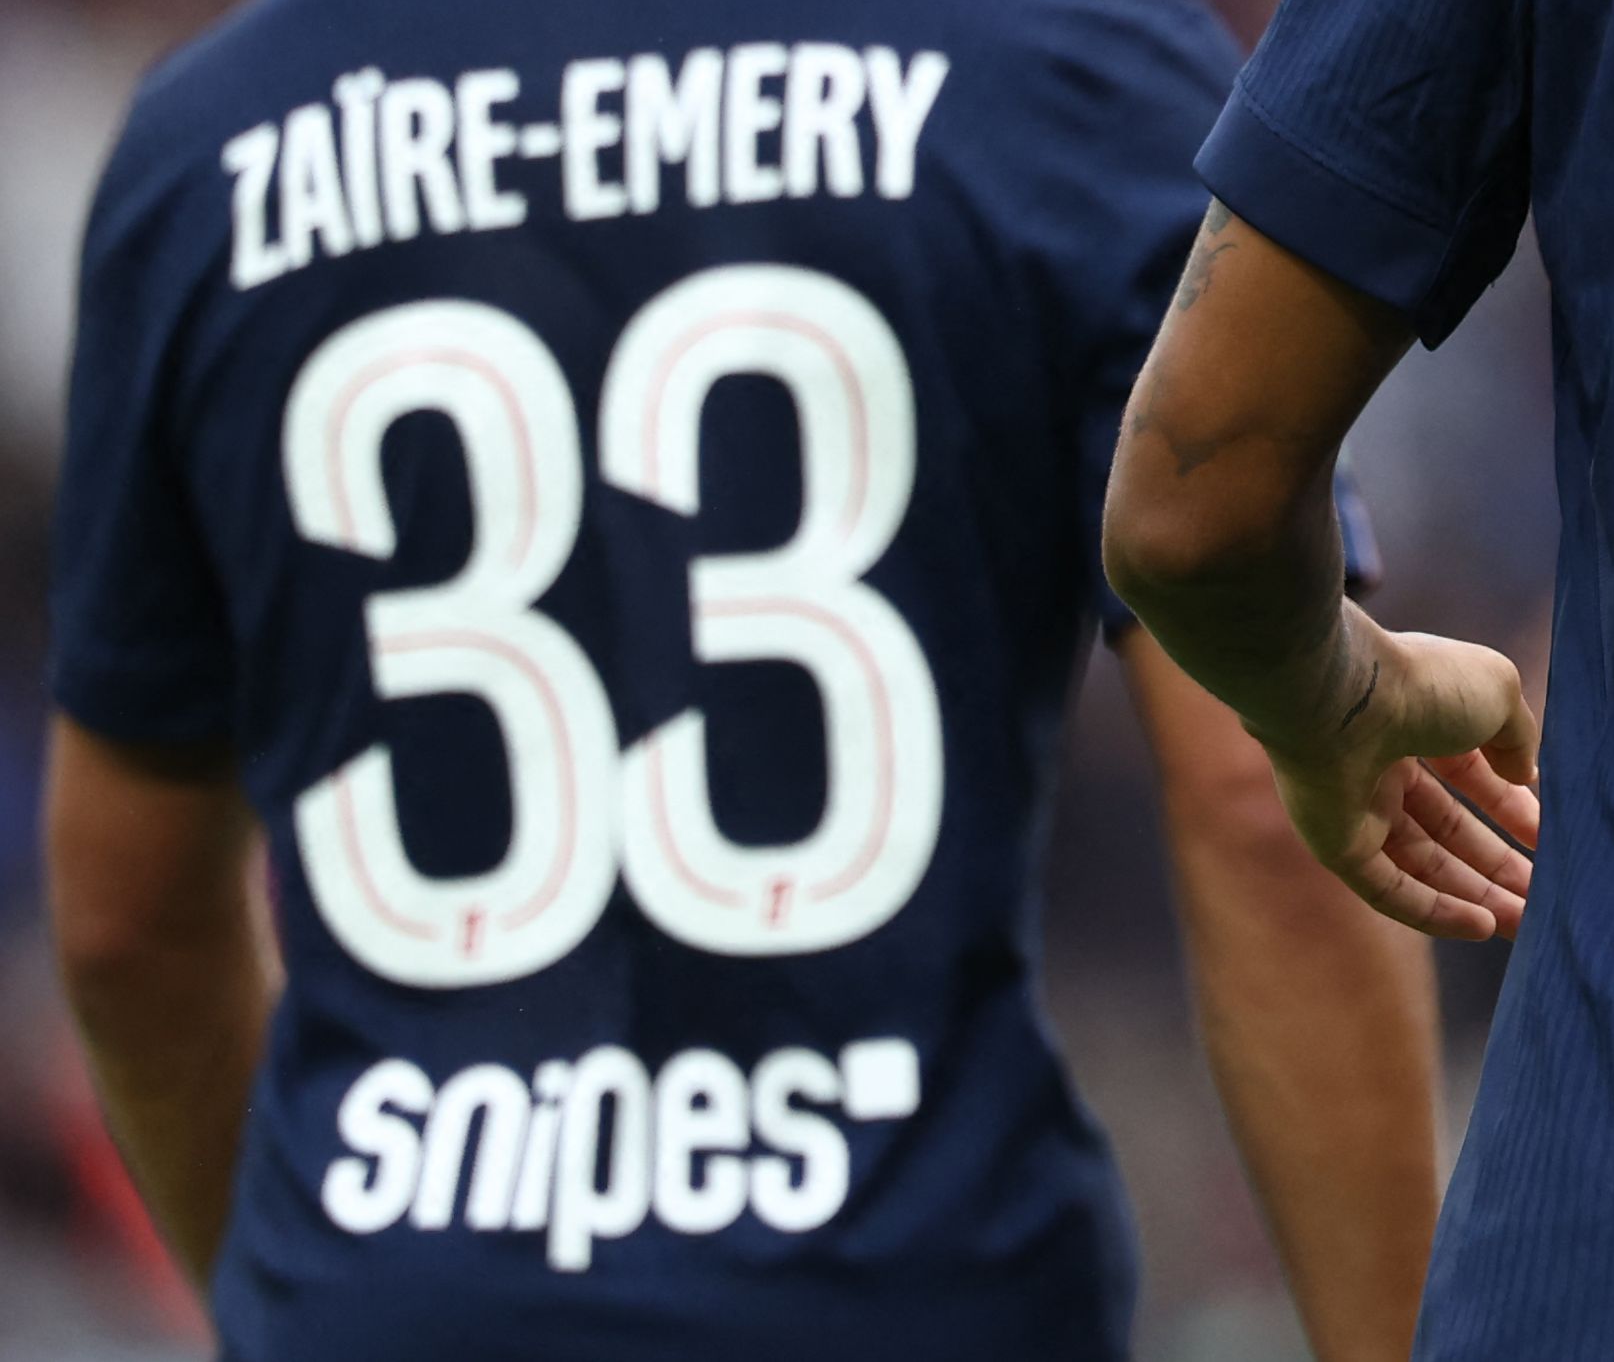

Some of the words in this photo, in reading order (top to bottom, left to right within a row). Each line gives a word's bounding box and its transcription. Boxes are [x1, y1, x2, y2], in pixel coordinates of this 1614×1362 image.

[221, 40, 951, 292] ZAÏRE-EMERY
[280, 263, 945, 989] 33
[322, 1044, 850, 1272] snipes
